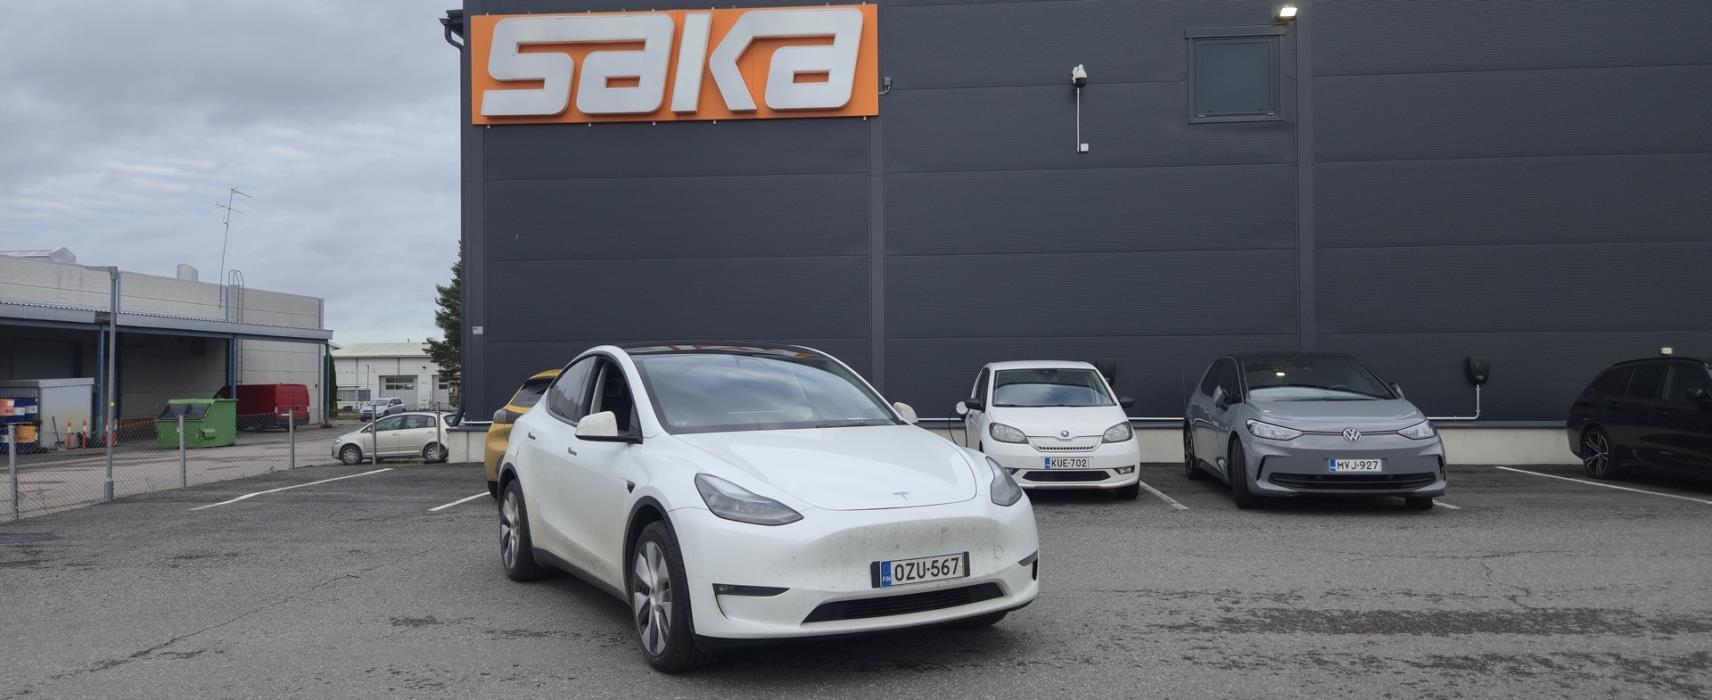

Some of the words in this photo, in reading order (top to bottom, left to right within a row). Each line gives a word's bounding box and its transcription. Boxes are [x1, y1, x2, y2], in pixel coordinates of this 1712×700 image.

[1051, 458, 1087, 468] KUE-702
[1337, 460, 1378, 470] MVJ-927
[894, 557, 960, 581] OZU-567
